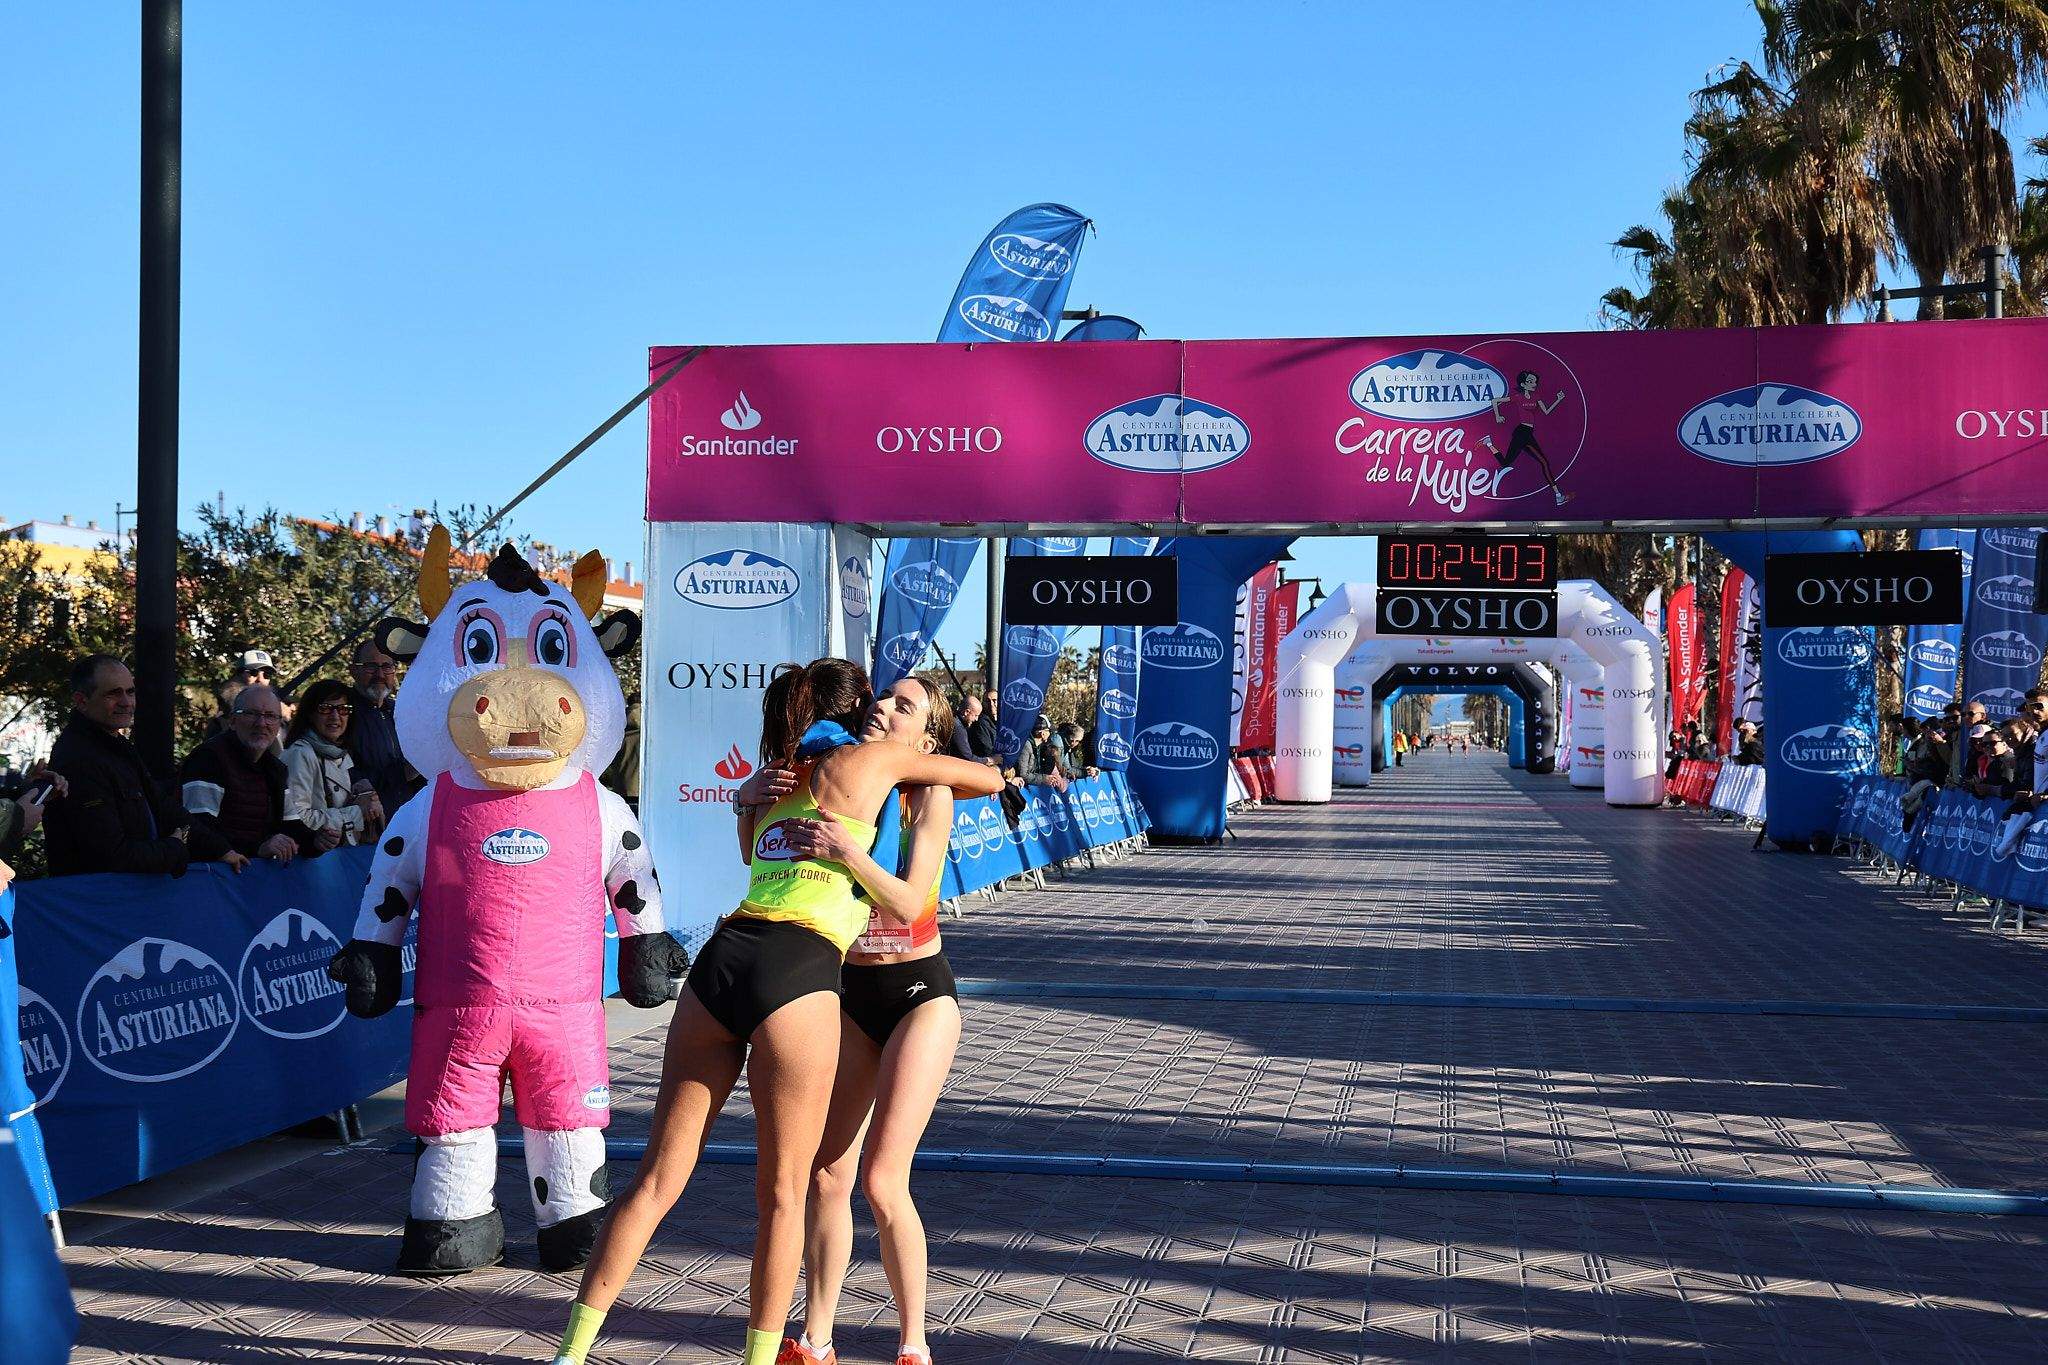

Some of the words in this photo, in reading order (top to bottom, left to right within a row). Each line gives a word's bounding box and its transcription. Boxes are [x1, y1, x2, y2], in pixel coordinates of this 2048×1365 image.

[964, 301, 1042, 338] ASTURIANA
[1385, 374, 1434, 382] CENTRAL
[1440, 372, 1491, 381] LECHERA
[1361, 377, 1495, 403] ASTURIANA
[1122, 421, 1174, 430] CENTRAL
[1720, 411, 1776, 421] CENTRAL
[1782, 410, 1841, 420] LECHERA
[876, 425, 1002, 453] OYSHO
[1096, 423, 1237, 453] ASTURIANA
[1335, 417, 1464, 455] Carrera
[1692, 416, 1847, 445] ASTURIANA
[682, 435, 799, 457] Santander
[1366, 456, 1390, 483] de
[1395, 456, 1413, 483] la
[1408, 451, 1514, 513] Mujer
[1389, 543, 1545, 582] 00:24:03
[684, 571, 790, 594] ASTURIANA
[1032, 579, 1153, 605] OYSHO
[1796, 577, 1934, 605] OYSHO
[1385, 595, 1550, 632] OYSHO
[1251, 587, 1267, 667] Santander
[1303, 629, 1348, 640] OYSHO
[1586, 627, 1633, 637] OYSHO
[1142, 638, 1219, 659] ASTURIANA
[1679, 607, 1692, 676] Santander
[1407, 666, 1498, 675] VOLVO
[1282, 688, 1324, 698] OYSHO
[1612, 688, 1656, 699] OYSHO
[1534, 701, 1543, 764] VOLVO
[1137, 738, 1214, 760] ASTURIANA
[1281, 747, 1322, 757] OYSHO
[1613, 750, 1656, 760] OYSHO
[486, 841, 545, 855] ASTURIANA
[800, 868, 833, 884] CORRE
[265, 951, 308, 972] CENTRAL
[113, 986, 167, 1008] CENTRAL
[170, 973, 220, 997] LECHERA
[96, 992, 233, 1058] ASTURIANA
